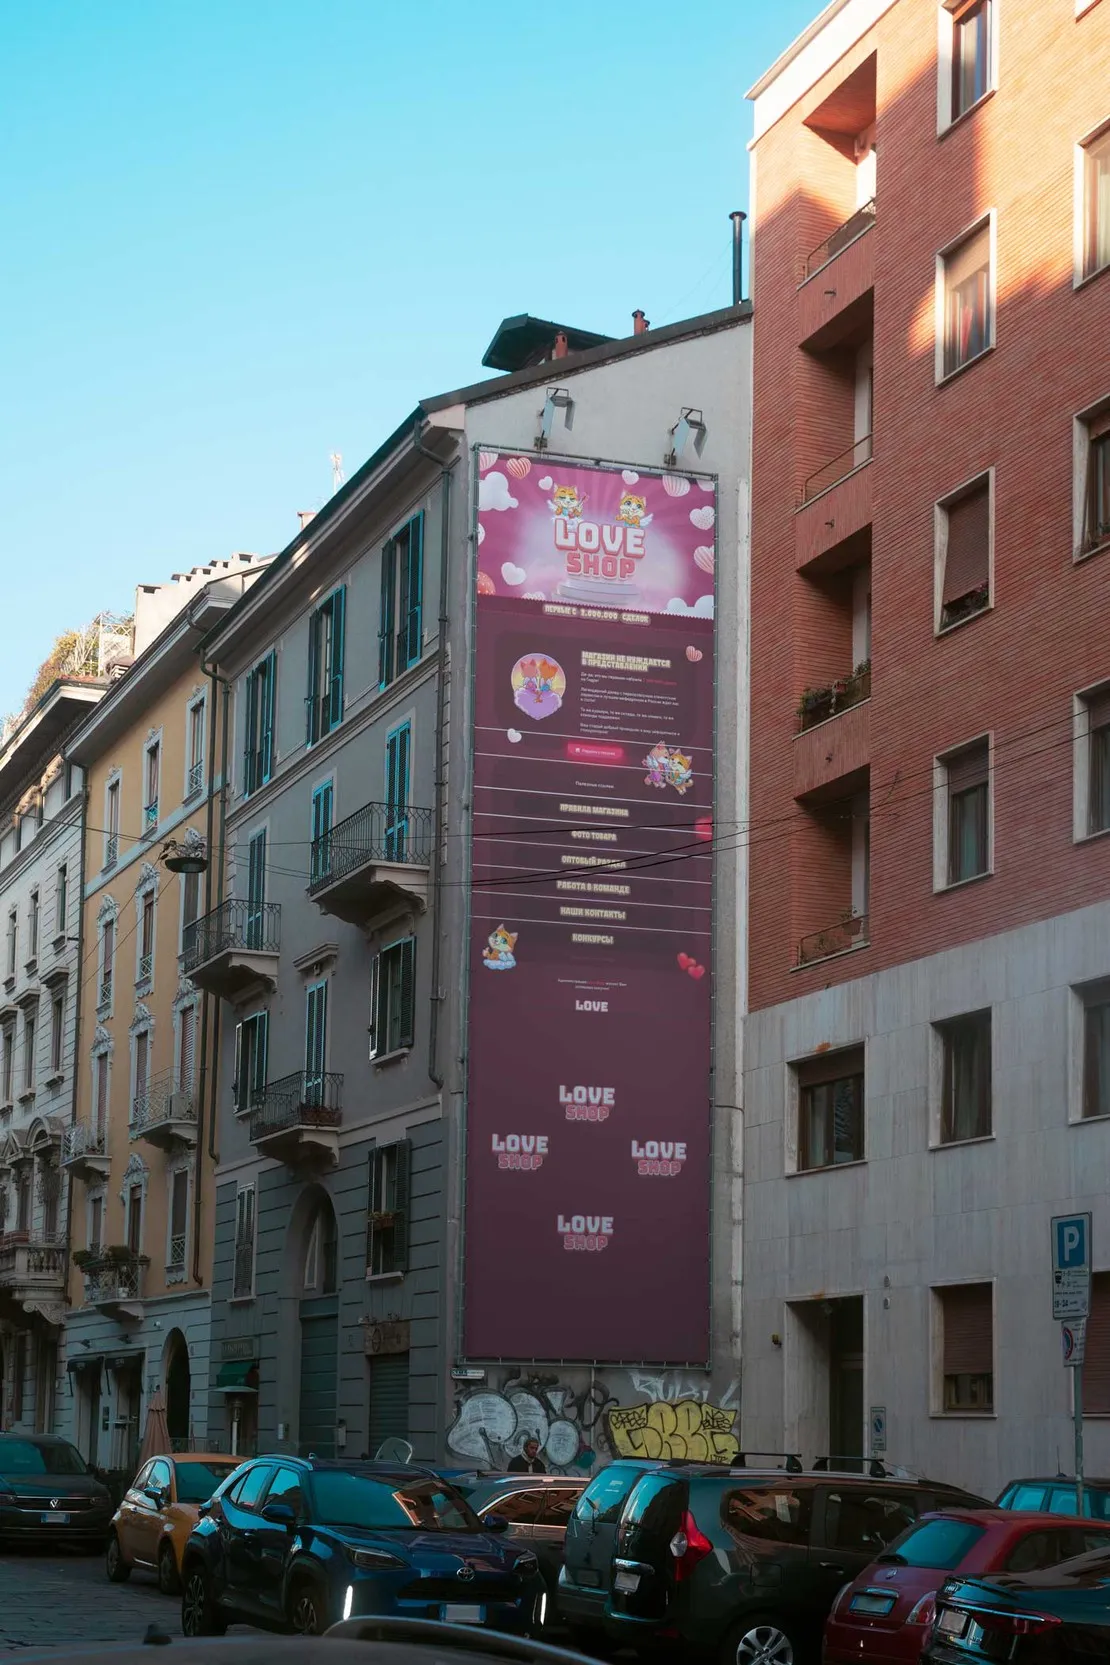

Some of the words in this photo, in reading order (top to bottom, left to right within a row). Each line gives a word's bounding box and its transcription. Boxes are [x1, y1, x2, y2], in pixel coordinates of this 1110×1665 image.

[554, 518, 646, 559] LOVE
[565, 551, 636, 579] SHOP
[581, 651, 616, 662] МАГАЗИН
[627, 655, 671, 668] НУЖДАЕТСЯ
[560, 803, 592, 814] ПРАВИЛА
[592, 806, 629, 817] МАГАЗИНА
[571, 830, 590, 839] ФОТО
[592, 832, 617, 841] ТОВАРА
[561, 855, 596, 865] ОПТОВЫЙ
[557, 880, 586, 891] РАБОТА
[593, 884, 631, 895] КОМАНДЕ
[560, 906, 583, 916] НАШИ
[585, 908, 626, 920] КОНТАКТЫ
[571, 933, 614, 944] КОНКУРСЫ
[575, 1000, 609, 1012] LOVE
[559, 1085, 615, 1105] LOVE
[565, 1104, 609, 1121] SHOP
[491, 1133, 549, 1154] LOVE
[631, 1140, 687, 1160] LOVE
[497, 1153, 543, 1170] SHOP
[637, 1159, 682, 1176] SHOP
[557, 1214, 614, 1235] LOVE
[563, 1234, 609, 1251] SHOP
[1063, 1225, 1080, 1262] P
